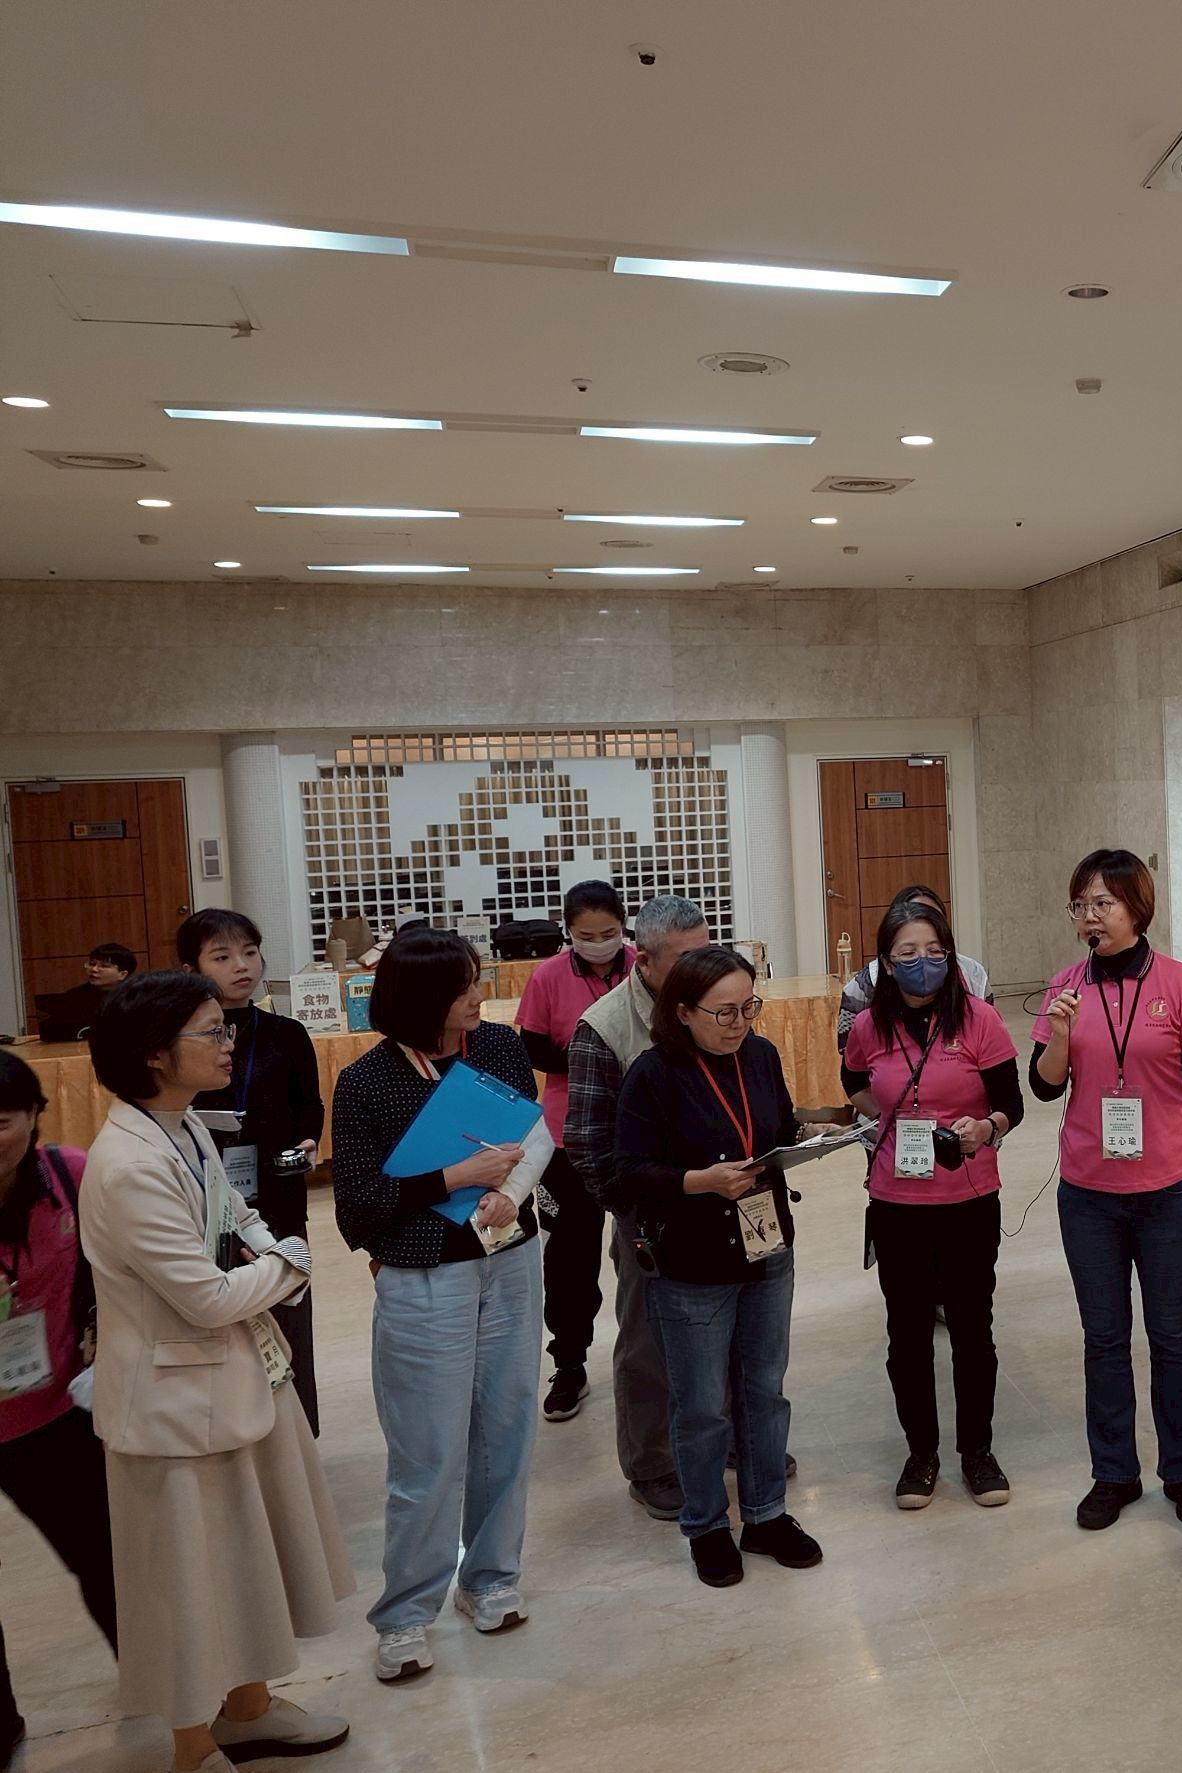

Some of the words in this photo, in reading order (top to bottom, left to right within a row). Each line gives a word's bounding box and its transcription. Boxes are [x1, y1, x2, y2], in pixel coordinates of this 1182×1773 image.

[302, 994, 330, 1007] 食物
[296, 1008, 337, 1021] 寄放處
